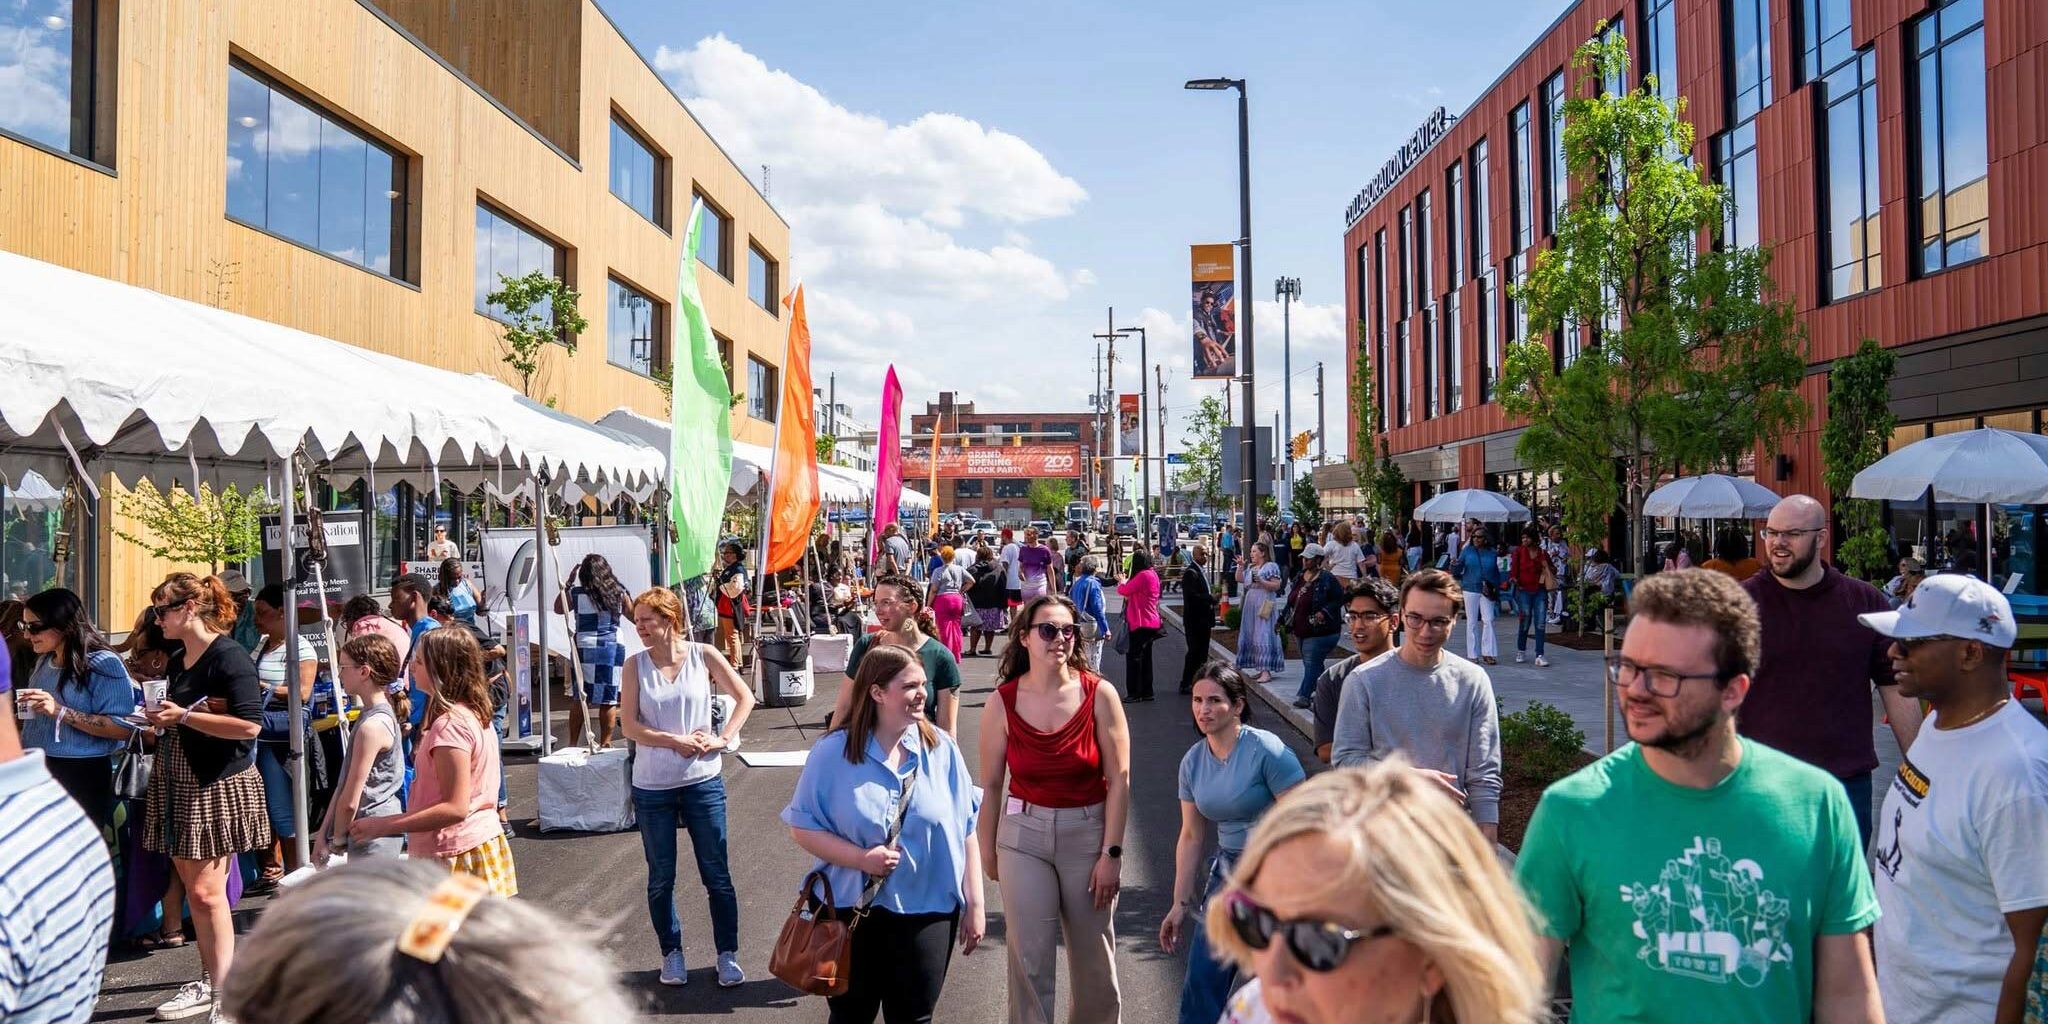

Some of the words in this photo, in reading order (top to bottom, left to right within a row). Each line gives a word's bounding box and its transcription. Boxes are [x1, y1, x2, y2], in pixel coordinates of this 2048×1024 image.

[1345, 146, 1405, 228] COLLABORATION
[1404, 106, 1447, 170] CENTER
[967, 458, 1012, 466] OPENING
[1658, 932, 1740, 974] MID
